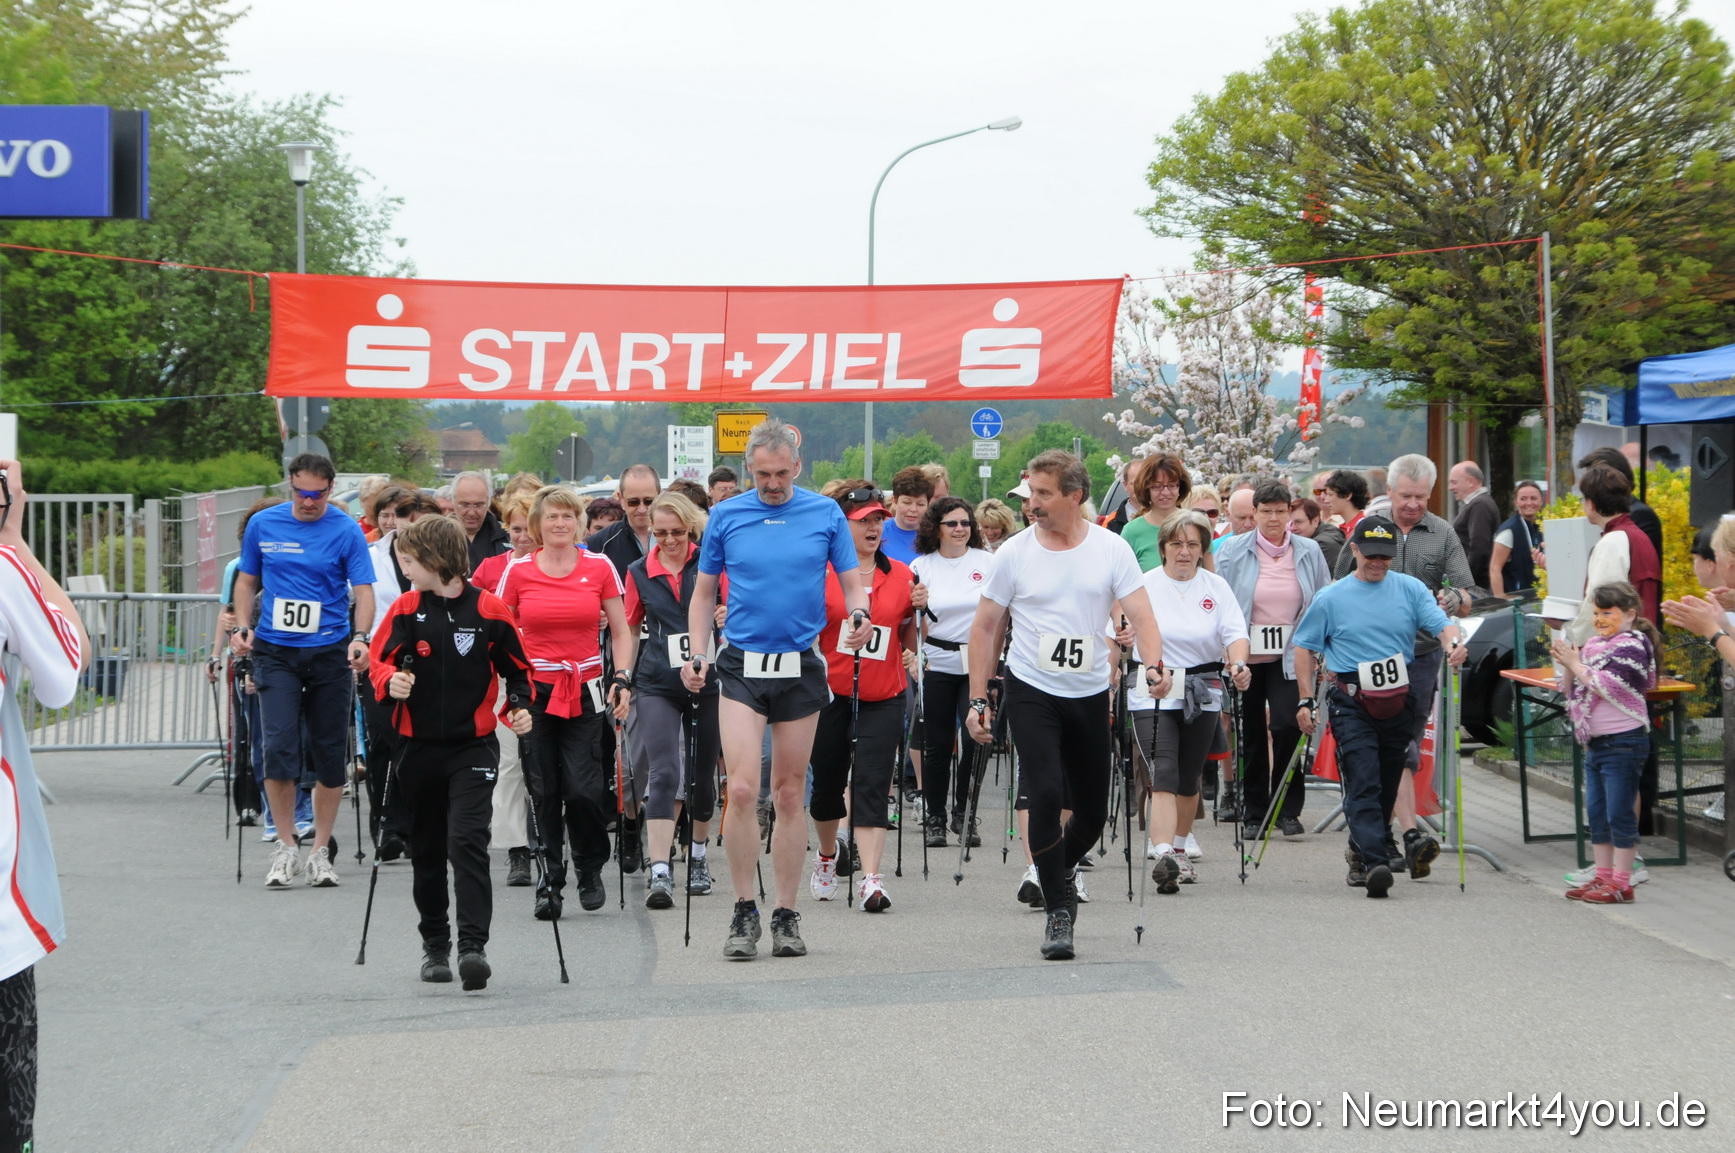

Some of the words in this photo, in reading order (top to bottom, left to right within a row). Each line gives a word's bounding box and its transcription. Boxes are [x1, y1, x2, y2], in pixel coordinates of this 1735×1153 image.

[722, 428, 752, 438] Neuma
[283, 601, 311, 628] 50
[1261, 626, 1283, 650] 111
[1050, 637, 1084, 669] 45
[1370, 658, 1400, 688] 89
